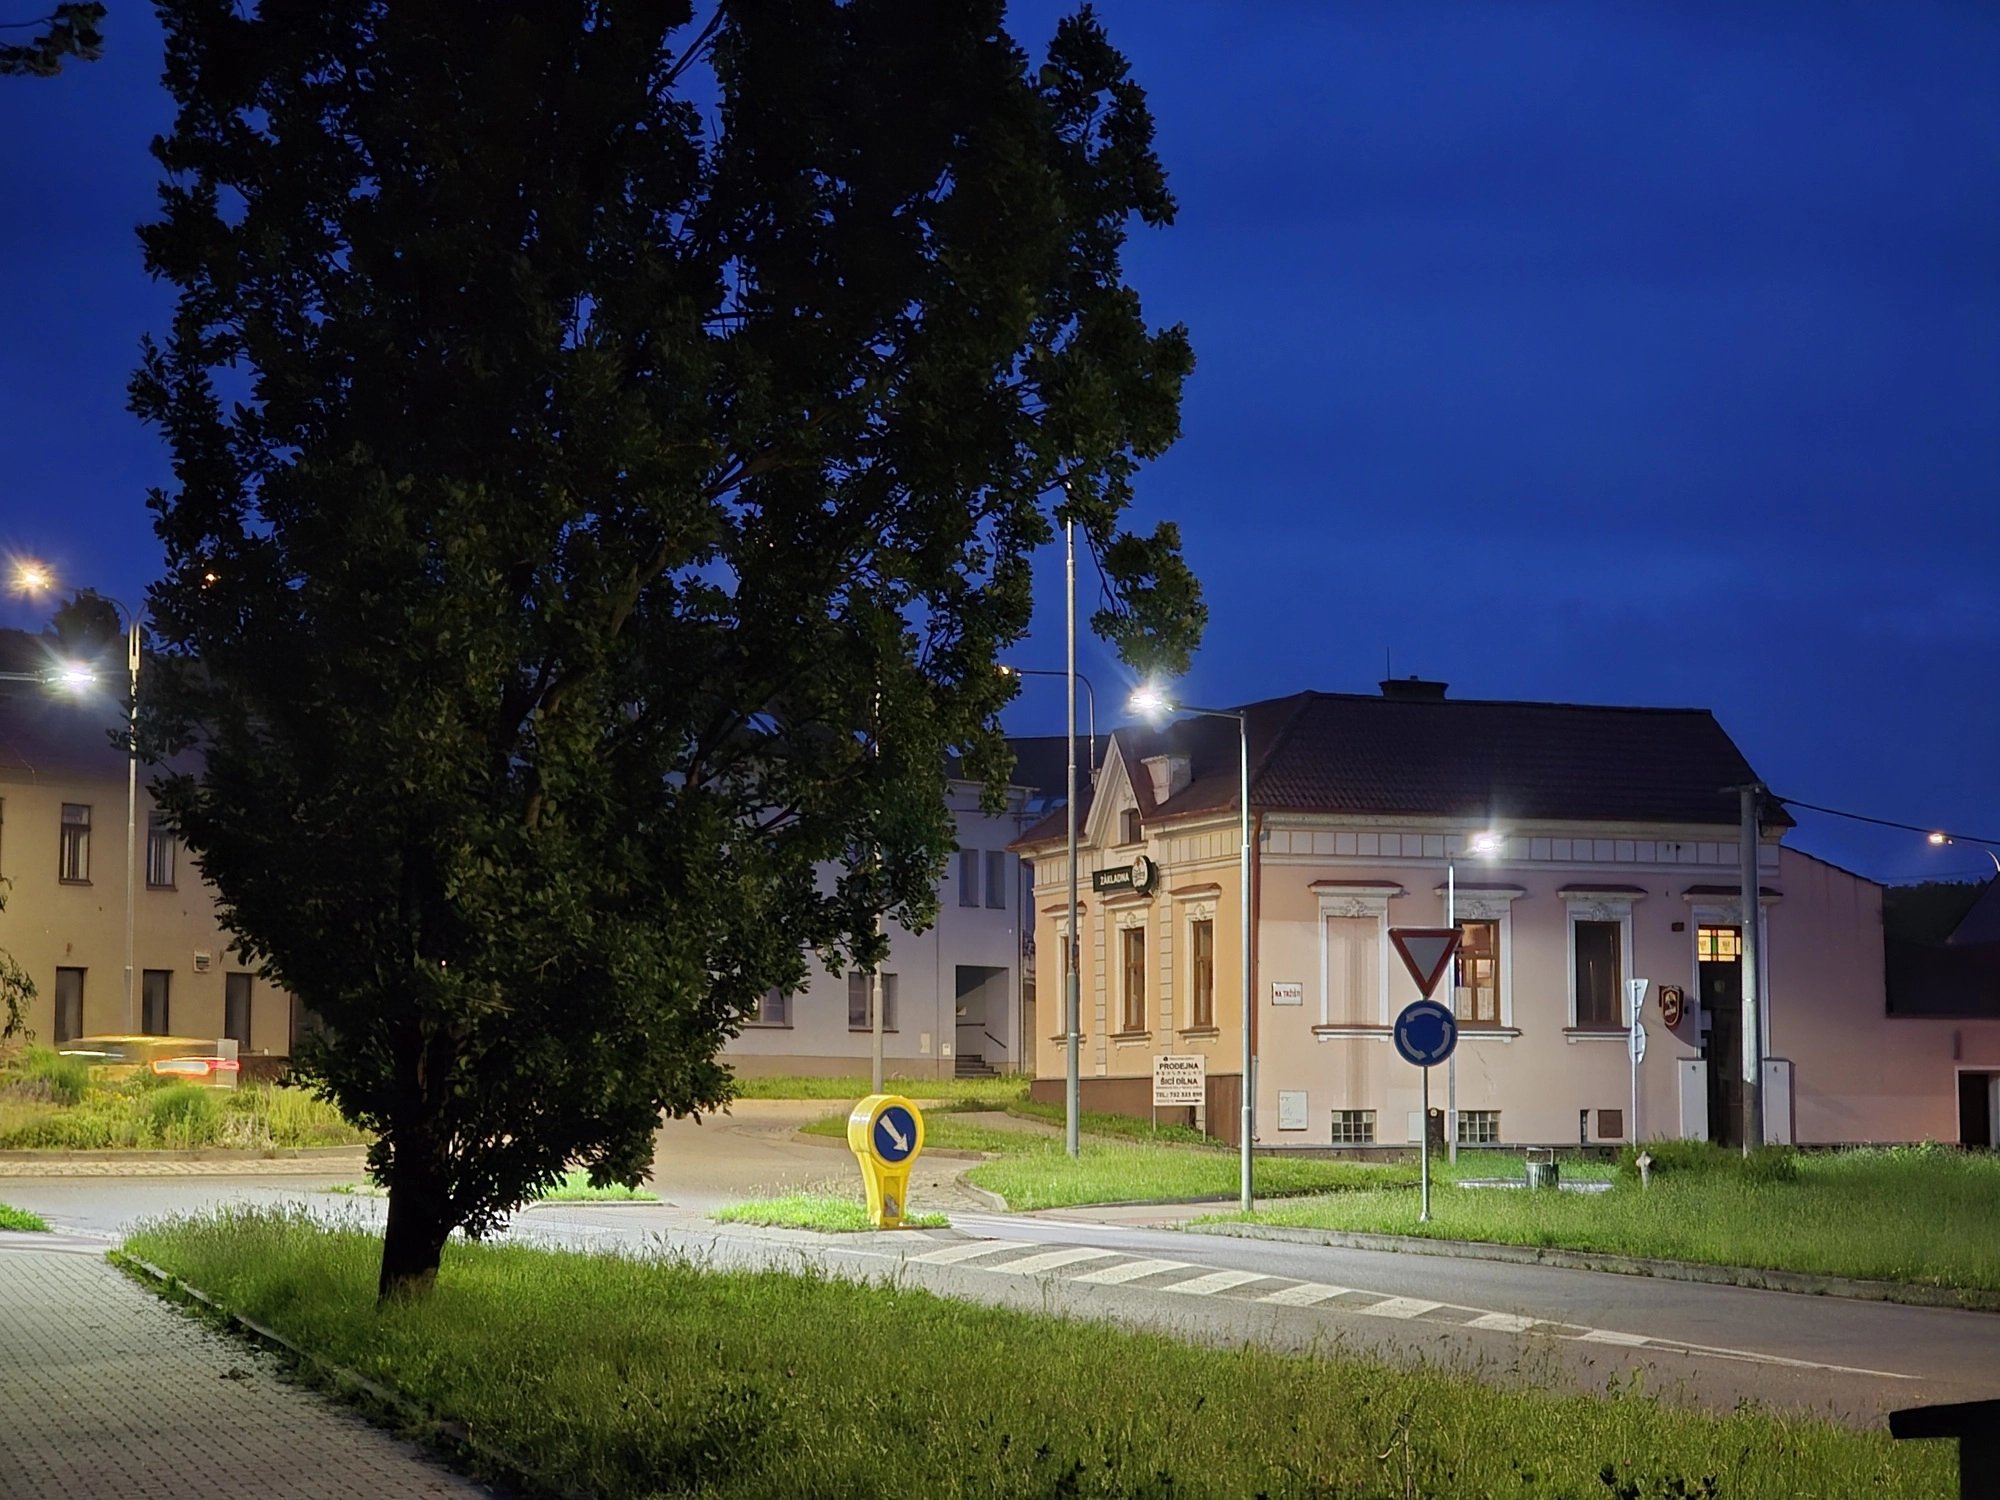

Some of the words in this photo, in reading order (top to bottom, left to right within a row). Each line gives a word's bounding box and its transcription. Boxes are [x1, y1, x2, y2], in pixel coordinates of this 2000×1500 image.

[1100, 872, 1130, 886] ZÁKLADNA
[1159, 1062, 1199, 1070] PRODEJNA
[1160, 1076, 1175, 1085] ŠICÍ
[1176, 1077, 1198, 1085] DÍLNA
